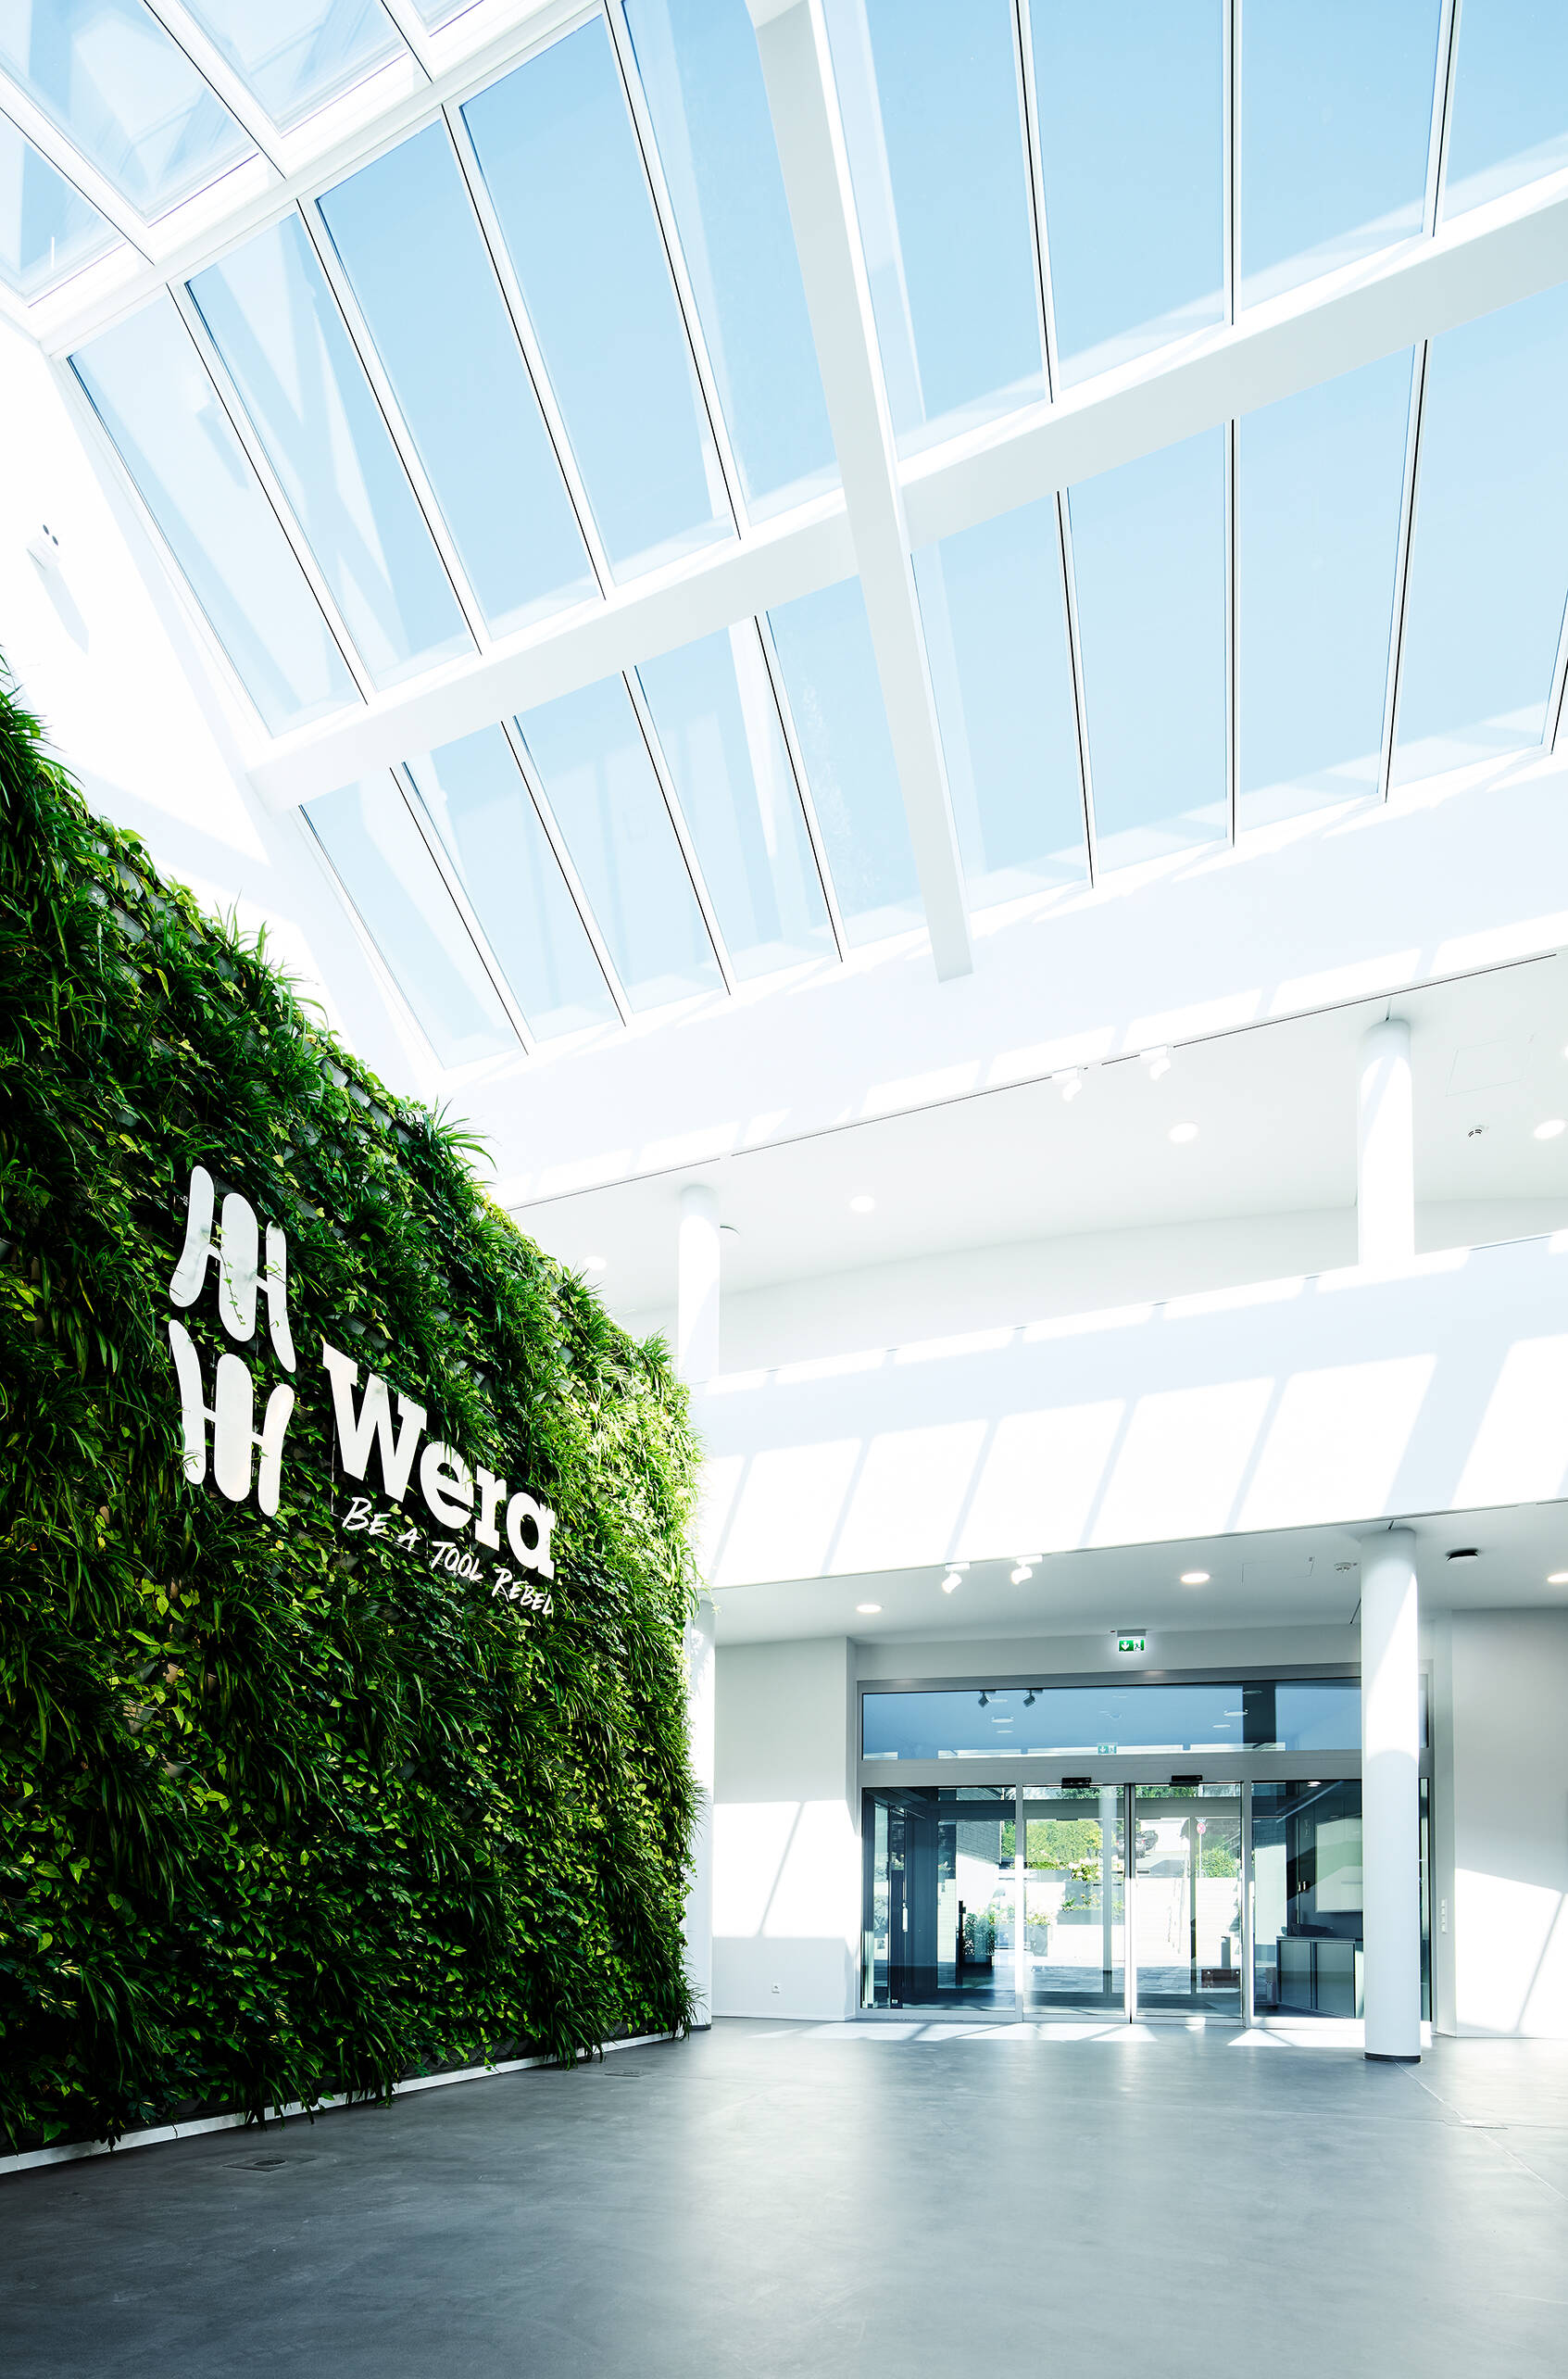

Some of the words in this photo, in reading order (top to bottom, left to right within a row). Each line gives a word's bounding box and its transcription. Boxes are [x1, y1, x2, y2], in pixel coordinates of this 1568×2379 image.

[322, 1341, 556, 1580] Wera
[342, 1497, 392, 1535] BE
[397, 1527, 421, 1552] A
[431, 1541, 483, 1580] TOOL
[492, 1567, 554, 1616] REBEL
